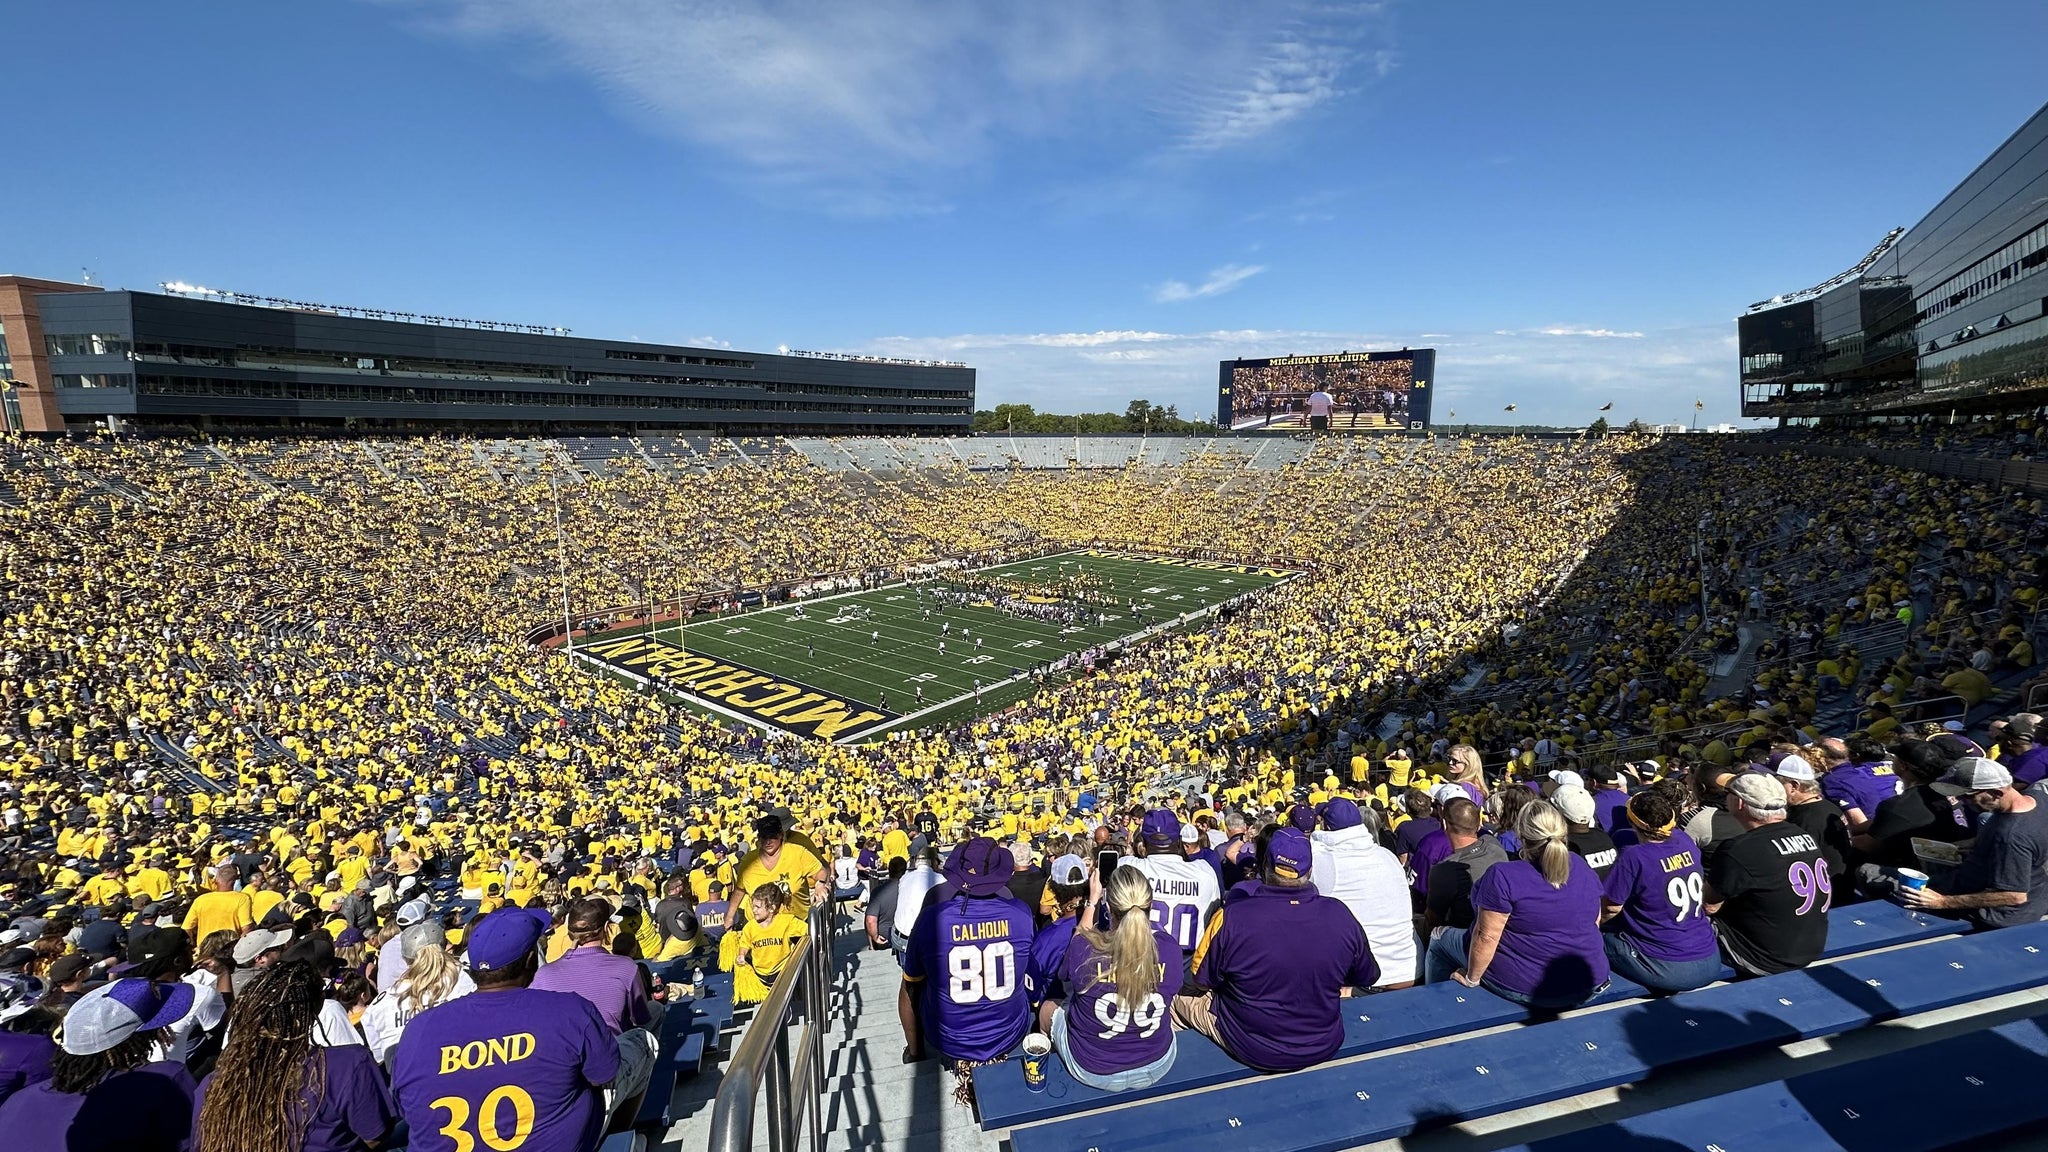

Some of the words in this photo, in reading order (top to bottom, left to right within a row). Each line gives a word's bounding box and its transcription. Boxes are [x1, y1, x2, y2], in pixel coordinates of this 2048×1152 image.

[1269, 356, 1320, 366] MICHIGAN
[1321, 353, 1370, 363] STADIUM
[1221, 387, 1230, 395] M
[1414, 380, 1426, 388] M
[589, 638, 887, 739] MICHIGAN
[920, 820, 932, 833] 16
[513, 869, 524, 877] M
[779, 872, 790, 881] M
[845, 867, 851, 881] 1
[1788, 857, 1833, 916] 99
[1667, 871, 1704, 923] 99
[952, 919, 1010, 942] CALHOUN
[752, 937, 784, 949] MICHIGAN
[948, 940, 1016, 1004] 80
[1093, 991, 1167, 1040] 99
[438, 1032, 536, 1076] BOND
[428, 1084, 536, 1152] 30
